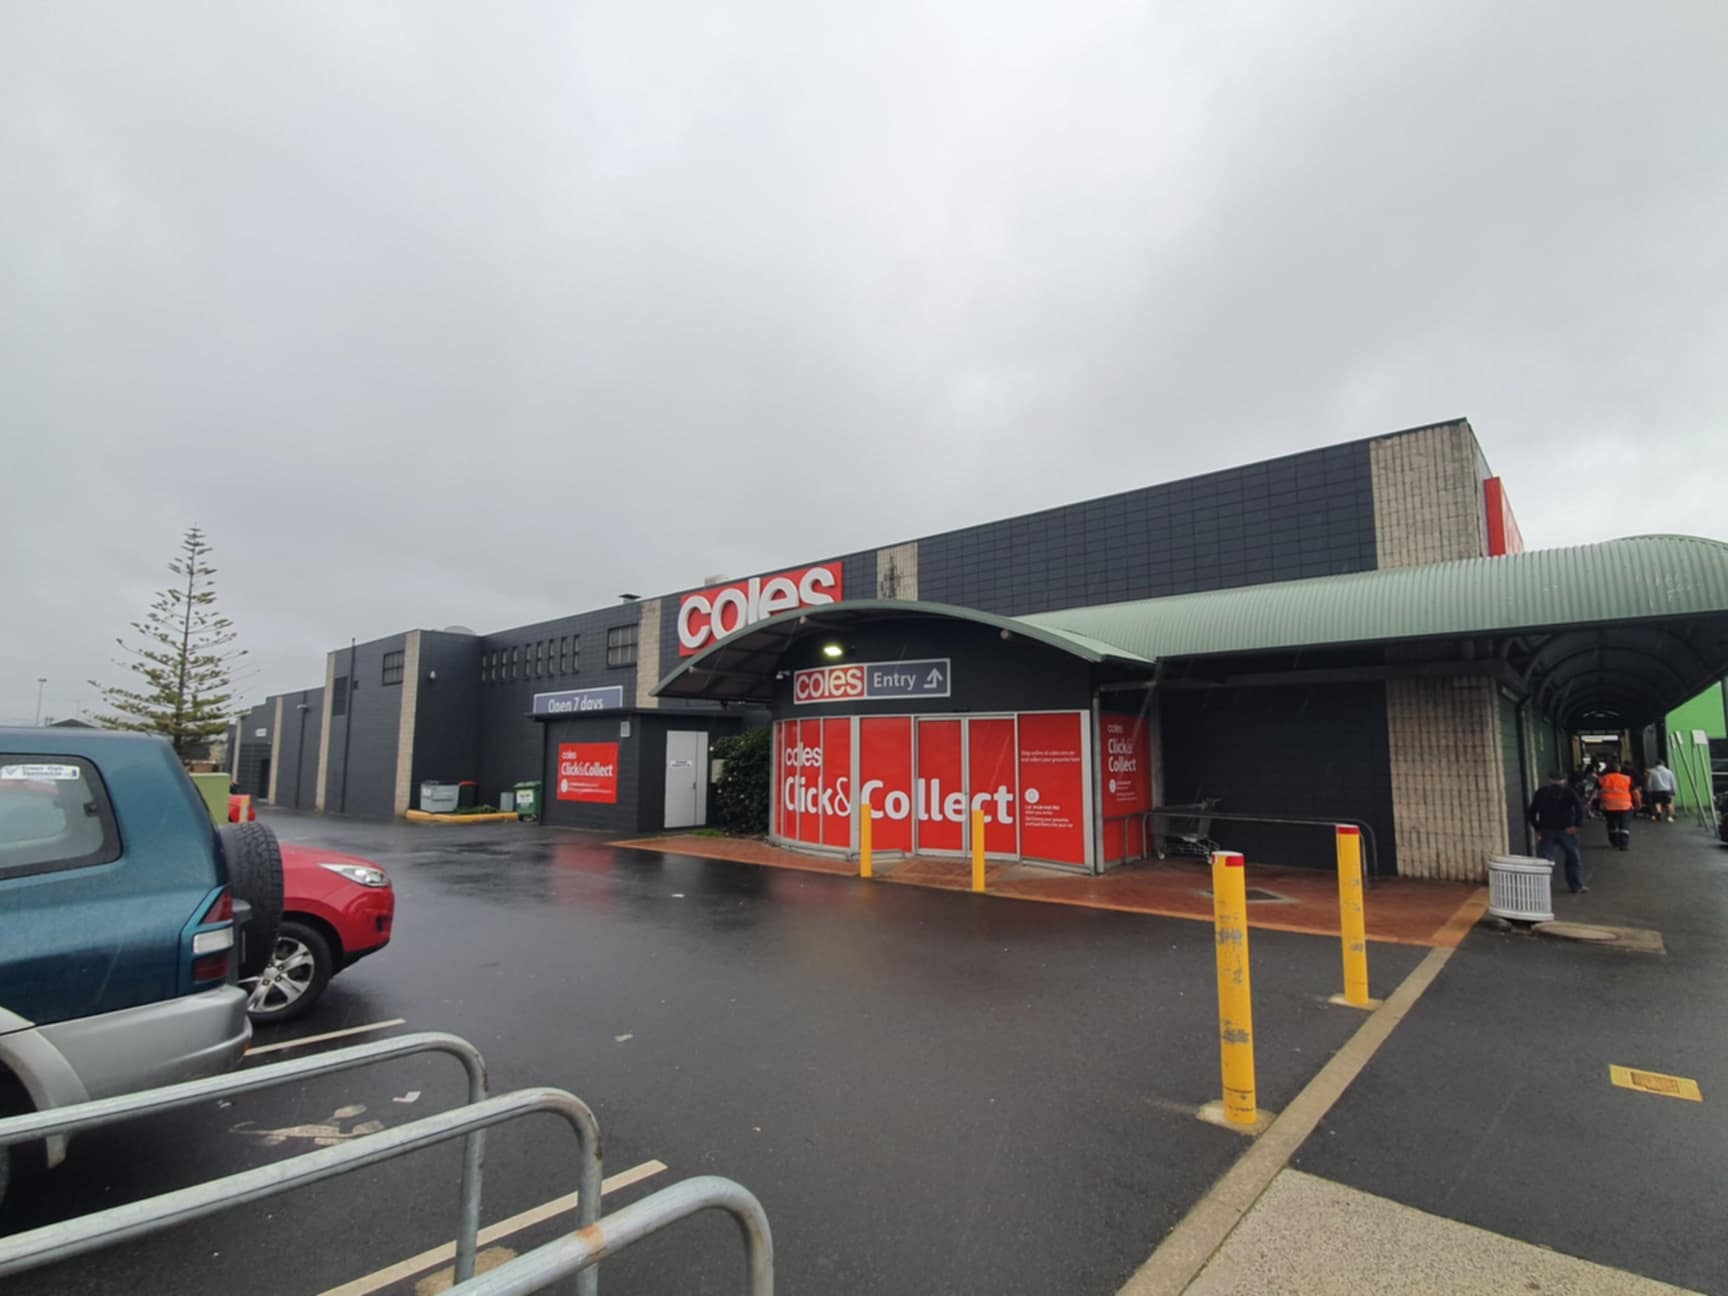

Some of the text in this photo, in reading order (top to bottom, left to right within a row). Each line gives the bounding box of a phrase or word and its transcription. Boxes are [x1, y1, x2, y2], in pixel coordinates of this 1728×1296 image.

[678, 567, 835, 648] coles
[796, 668, 916, 699] coles Entry
[548, 695, 604, 713] Open 7 days
[785, 742, 822, 768] coles
[1109, 756, 1136, 772] Collect
